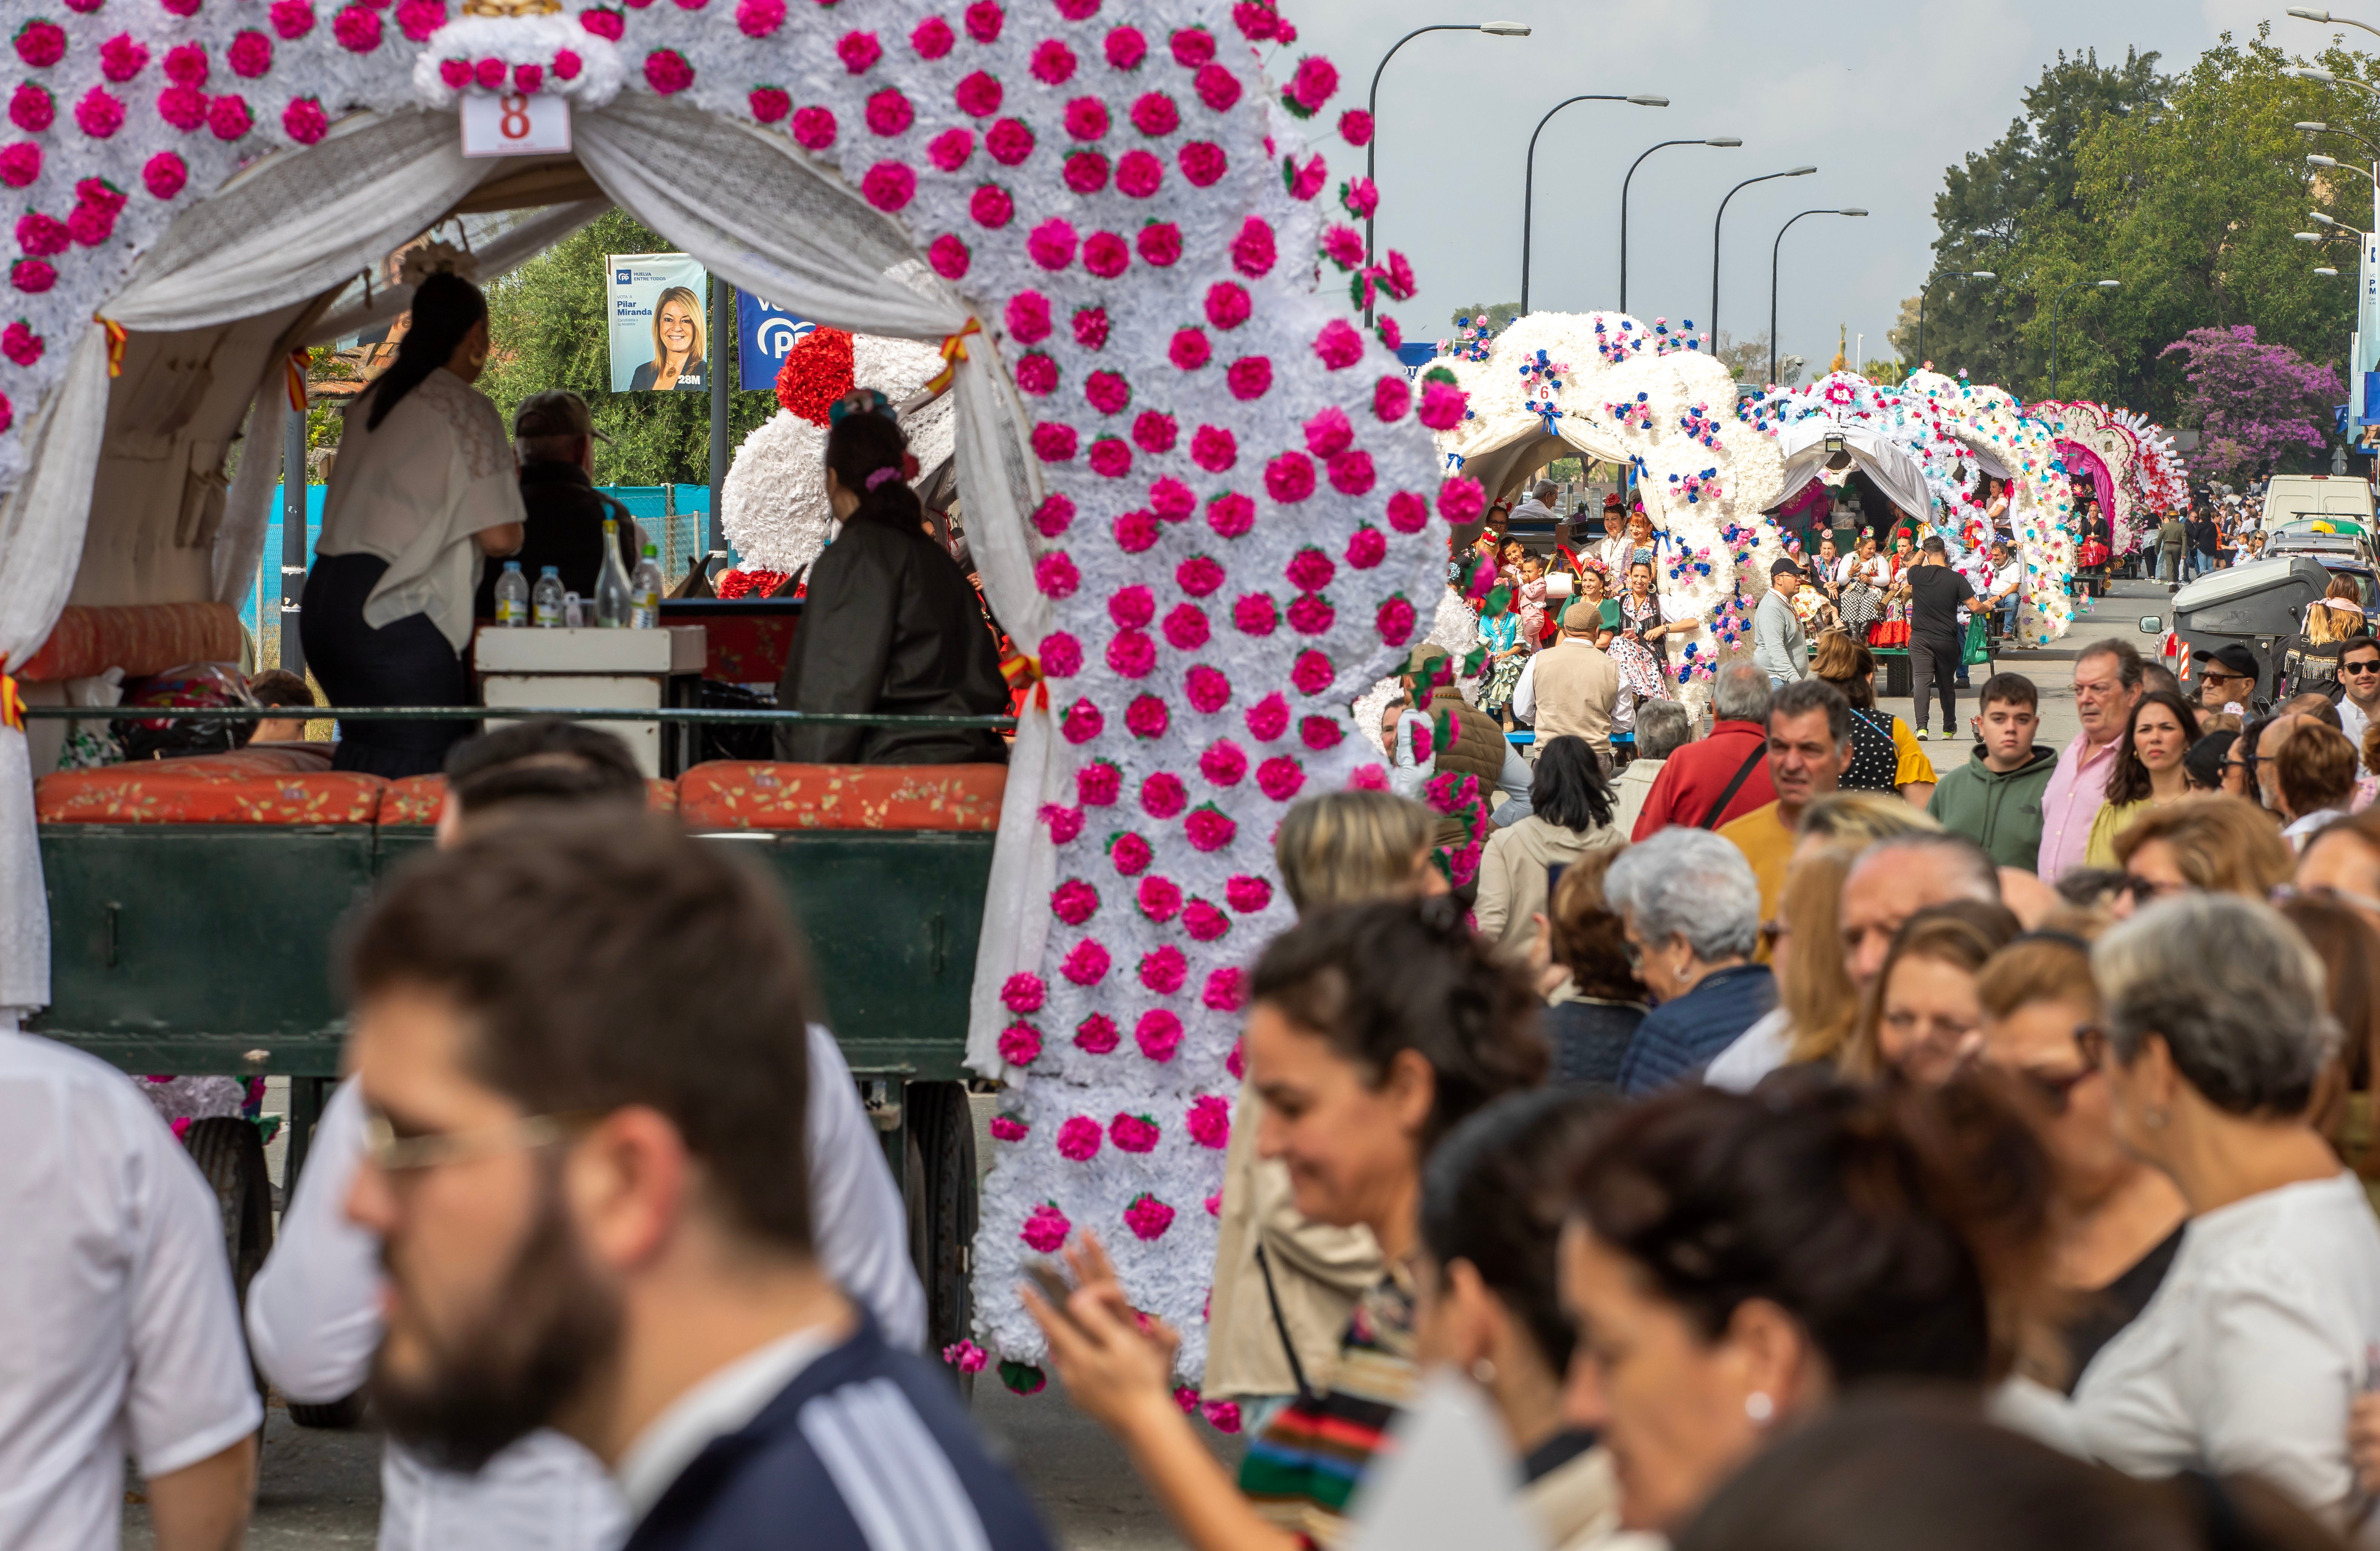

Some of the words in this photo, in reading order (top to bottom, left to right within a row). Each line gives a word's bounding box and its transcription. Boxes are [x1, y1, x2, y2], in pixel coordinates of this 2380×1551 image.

[501, 92, 530, 138] 8
[678, 375, 700, 385] 28M
[1540, 386, 1549, 399] 6
[1838, 389, 1844, 398] 5
